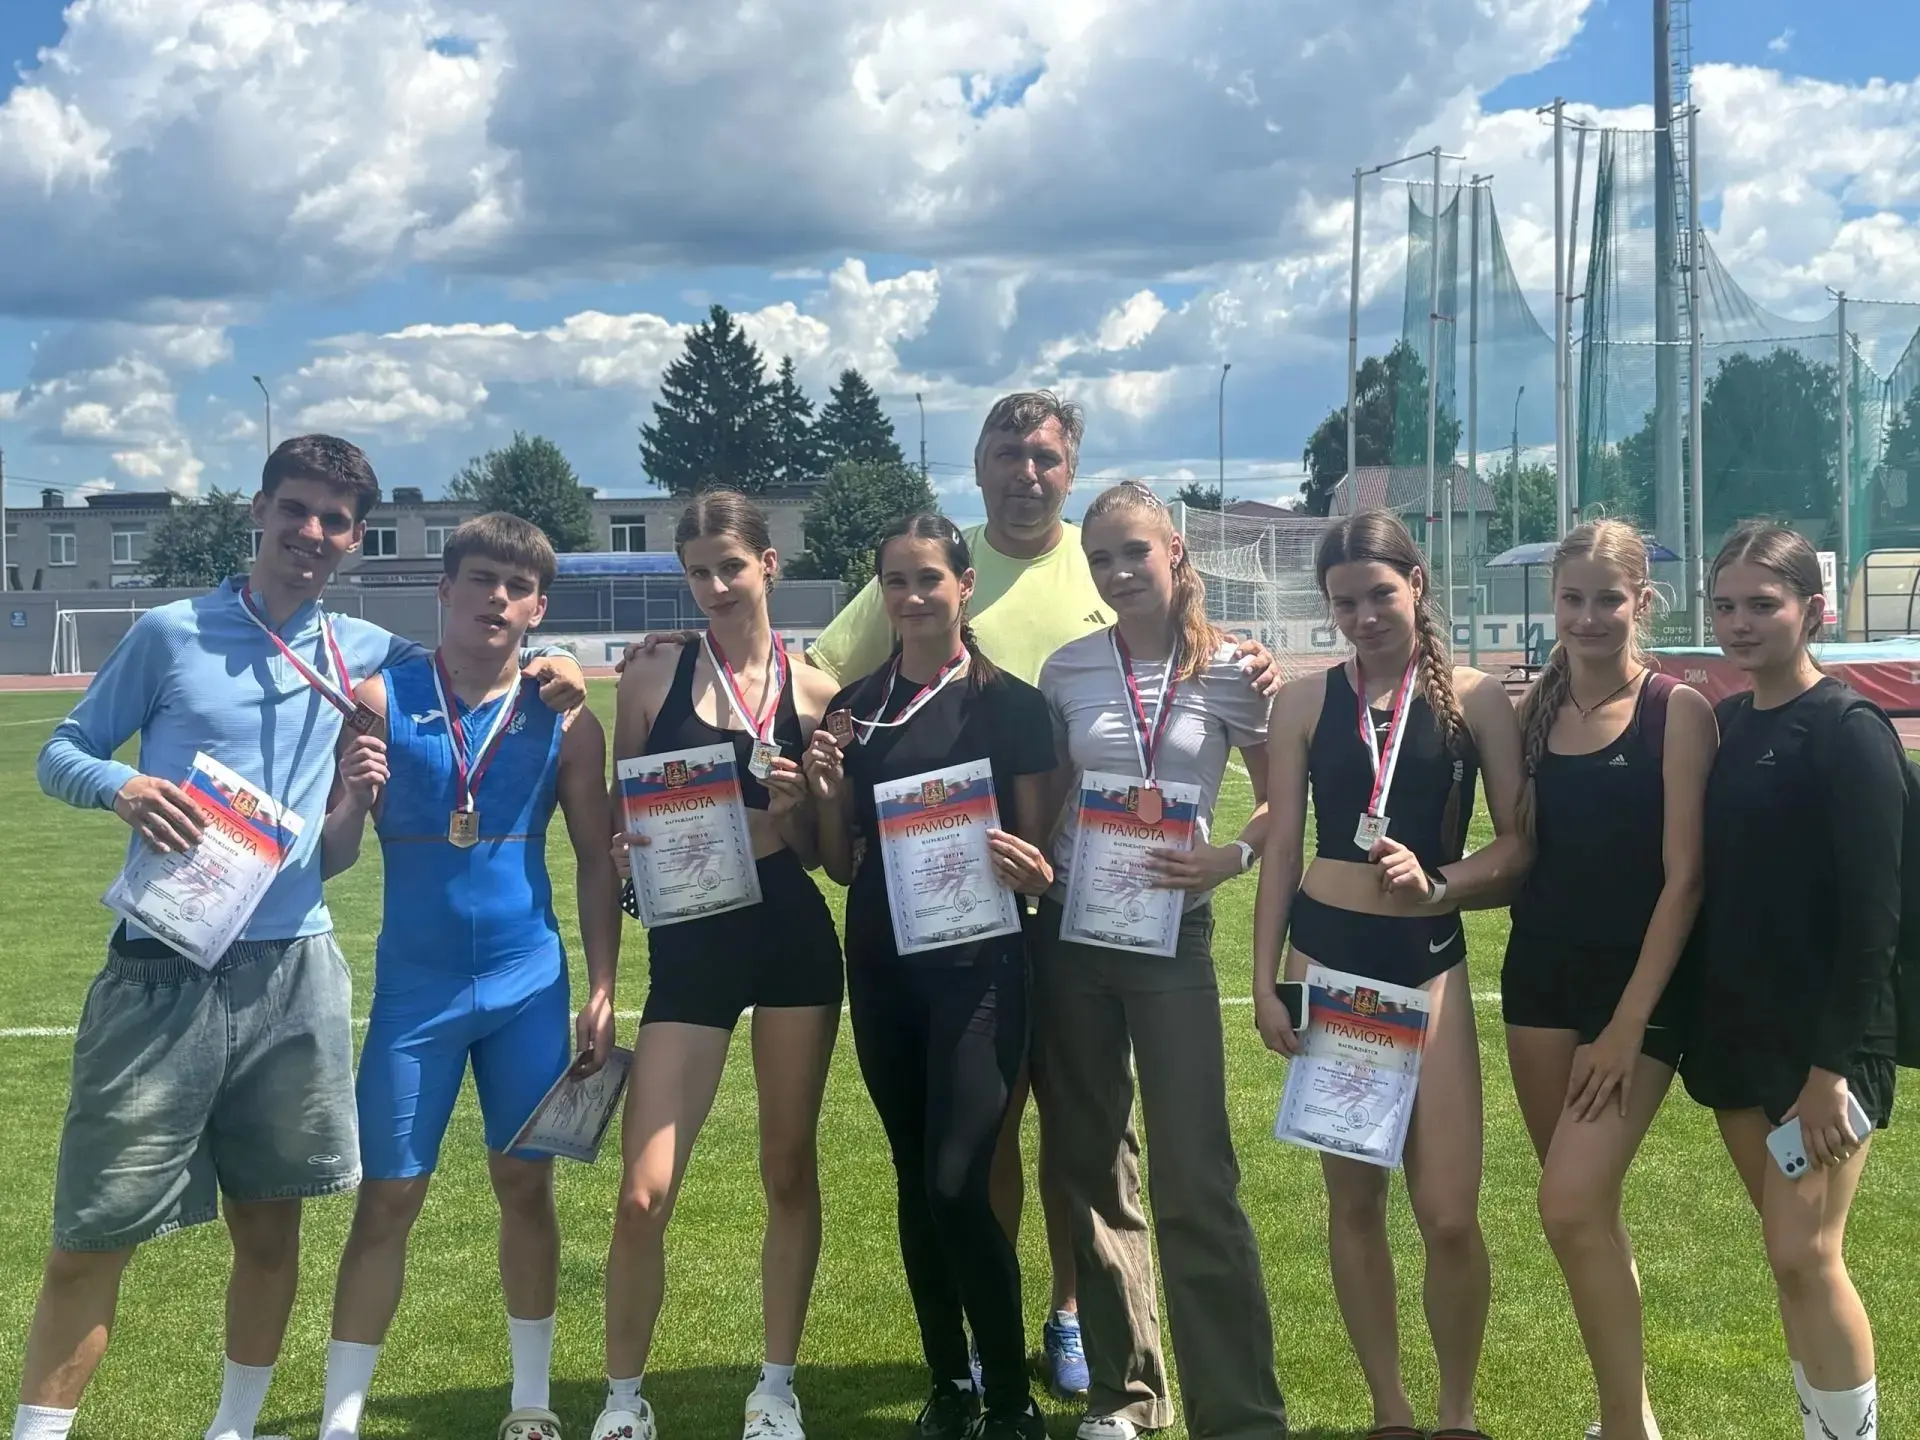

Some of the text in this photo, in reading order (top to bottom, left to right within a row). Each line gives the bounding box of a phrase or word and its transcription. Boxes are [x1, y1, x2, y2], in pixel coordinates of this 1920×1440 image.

[648, 796, 716, 817] ГРАМОТА
[905, 813, 972, 838] ГРАМОТА
[1101, 822, 1166, 842] ГРАМОТА
[1325, 1021, 1395, 1049] ГРАМОТА
